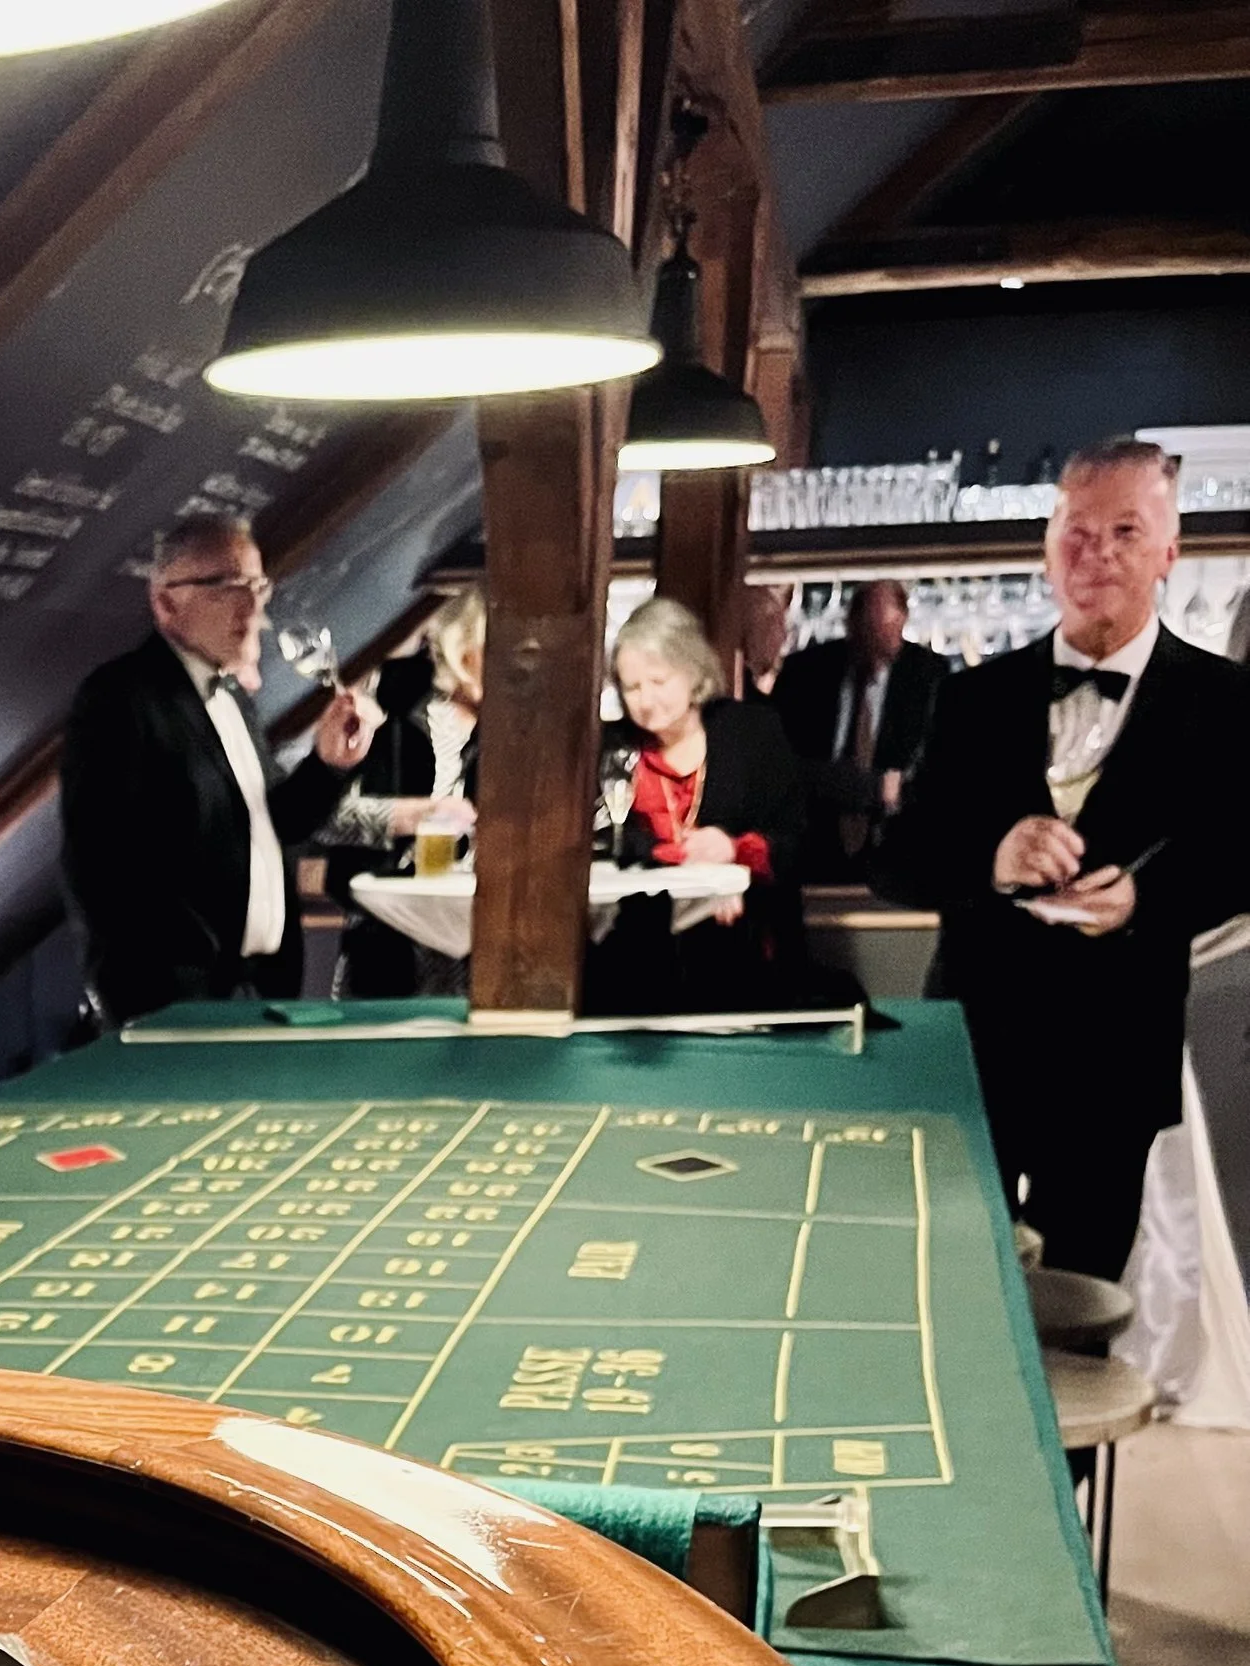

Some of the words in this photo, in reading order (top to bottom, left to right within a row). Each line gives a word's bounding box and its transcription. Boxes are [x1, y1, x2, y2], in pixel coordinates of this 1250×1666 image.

[163, 1315, 218, 1333] 11
[330, 1325, 398, 1344] 10
[128, 1353, 176, 1373] 8
[311, 1364, 352, 1384] 7
[499, 1346, 592, 1411] PASSE
